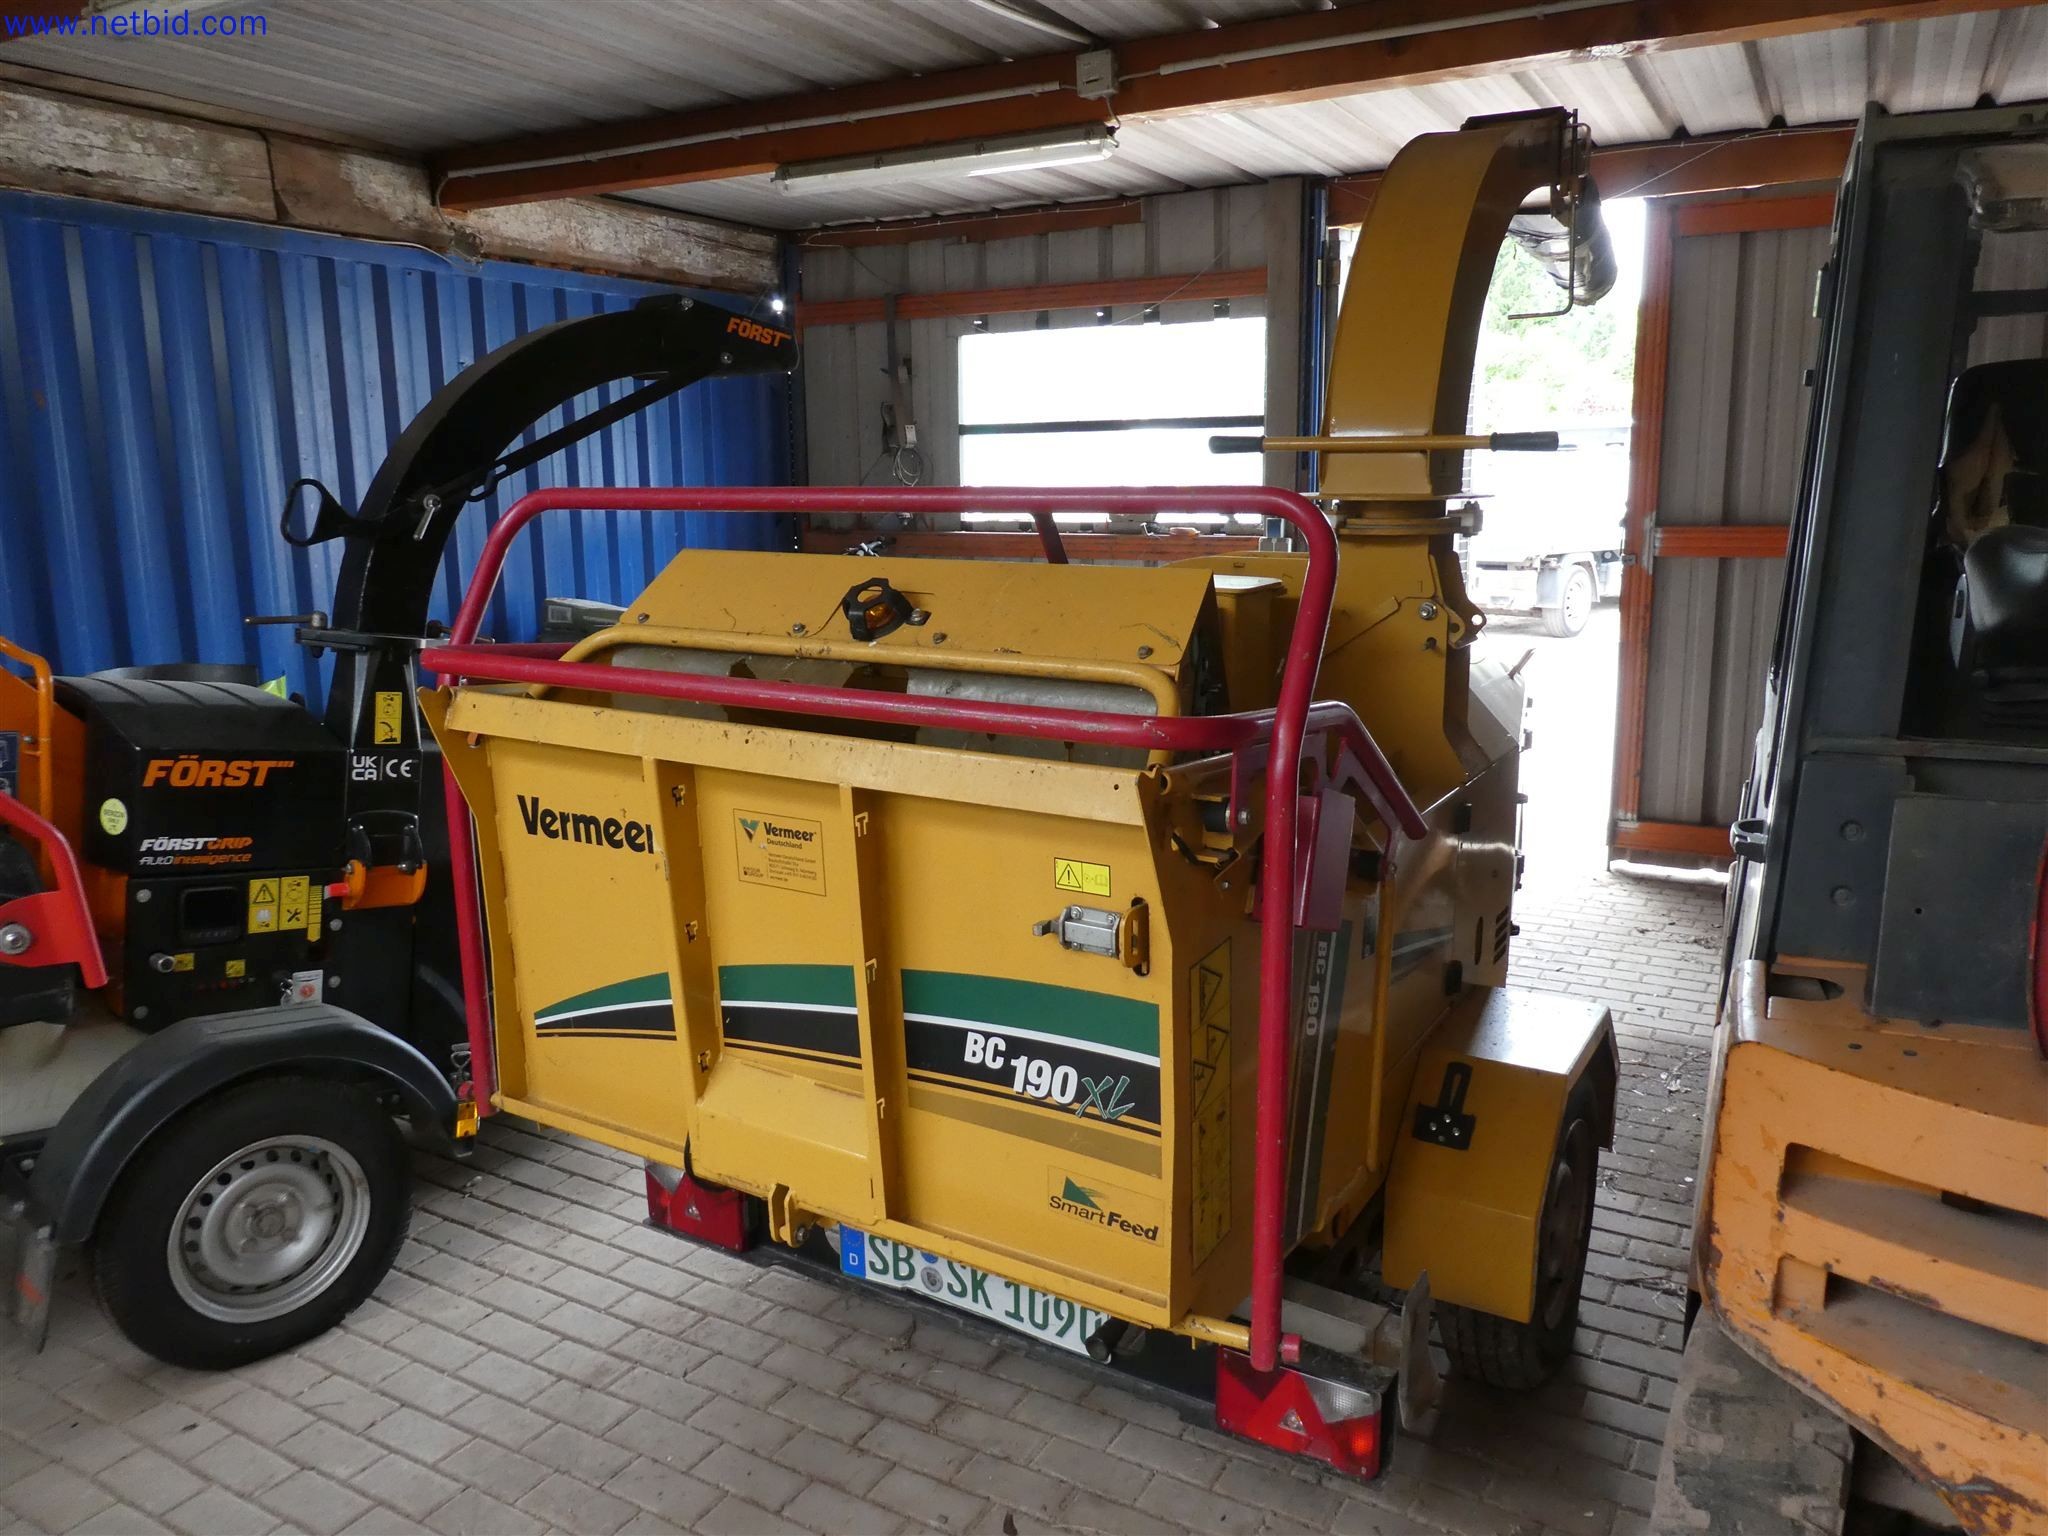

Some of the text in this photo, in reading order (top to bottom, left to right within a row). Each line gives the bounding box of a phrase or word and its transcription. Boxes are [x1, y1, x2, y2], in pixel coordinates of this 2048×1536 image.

[727, 317, 792, 347] FÖRST
[142, 755, 295, 787] FÖRST
[352, 755, 378, 768] UK
[385, 758, 413, 778] CE
[351, 768, 378, 781] CA
[763, 821, 815, 842] Vermeer
[766, 838, 803, 850] Deutschland
[963, 1031, 1007, 1070] BC
[1010, 1055, 1079, 1106] 190
[848, 1251, 859, 1267] D
[867, 1233, 916, 1282] SB
[946, 1258, 993, 1311] SK
